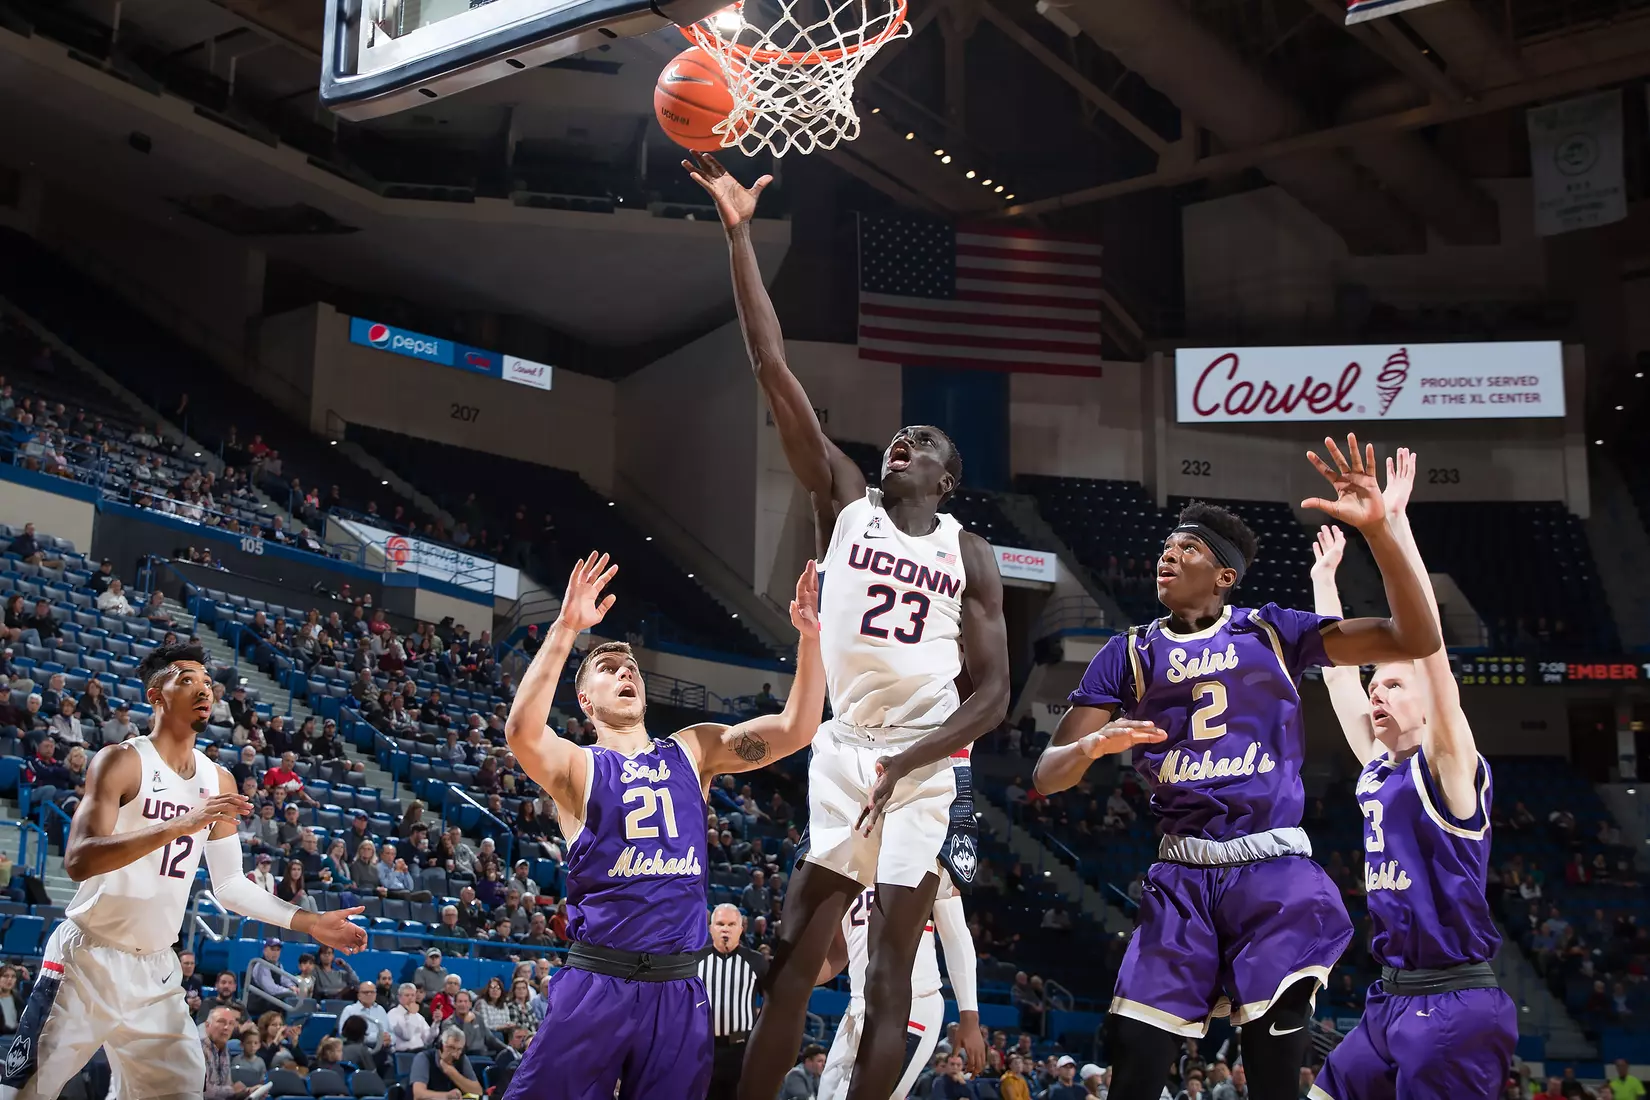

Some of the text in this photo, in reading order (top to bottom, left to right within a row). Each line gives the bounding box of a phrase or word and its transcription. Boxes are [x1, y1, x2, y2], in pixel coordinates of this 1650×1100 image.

[661, 106, 690, 126] UCONN
[392, 334, 439, 356] pepsi
[1193, 352, 1362, 417] Carvel
[1420, 376, 1540, 388] PROUDLY SERVED
[1422, 392, 1541, 405] AT THE XL CENTER
[450, 403, 481, 424] 207
[1181, 460, 1212, 477] 232
[1427, 468, 1461, 485] 233
[240, 537, 264, 556] 105
[848, 543, 961, 599] UCONN
[1002, 552, 1045, 567] RICOH
[860, 583, 931, 645] 23
[1167, 643, 1239, 684] Saint
[1191, 680, 1229, 741] 2
[620, 759, 671, 784] Sant
[1158, 741, 1276, 784] Michael's
[622, 786, 679, 840] 21
[159, 835, 194, 879] 12
